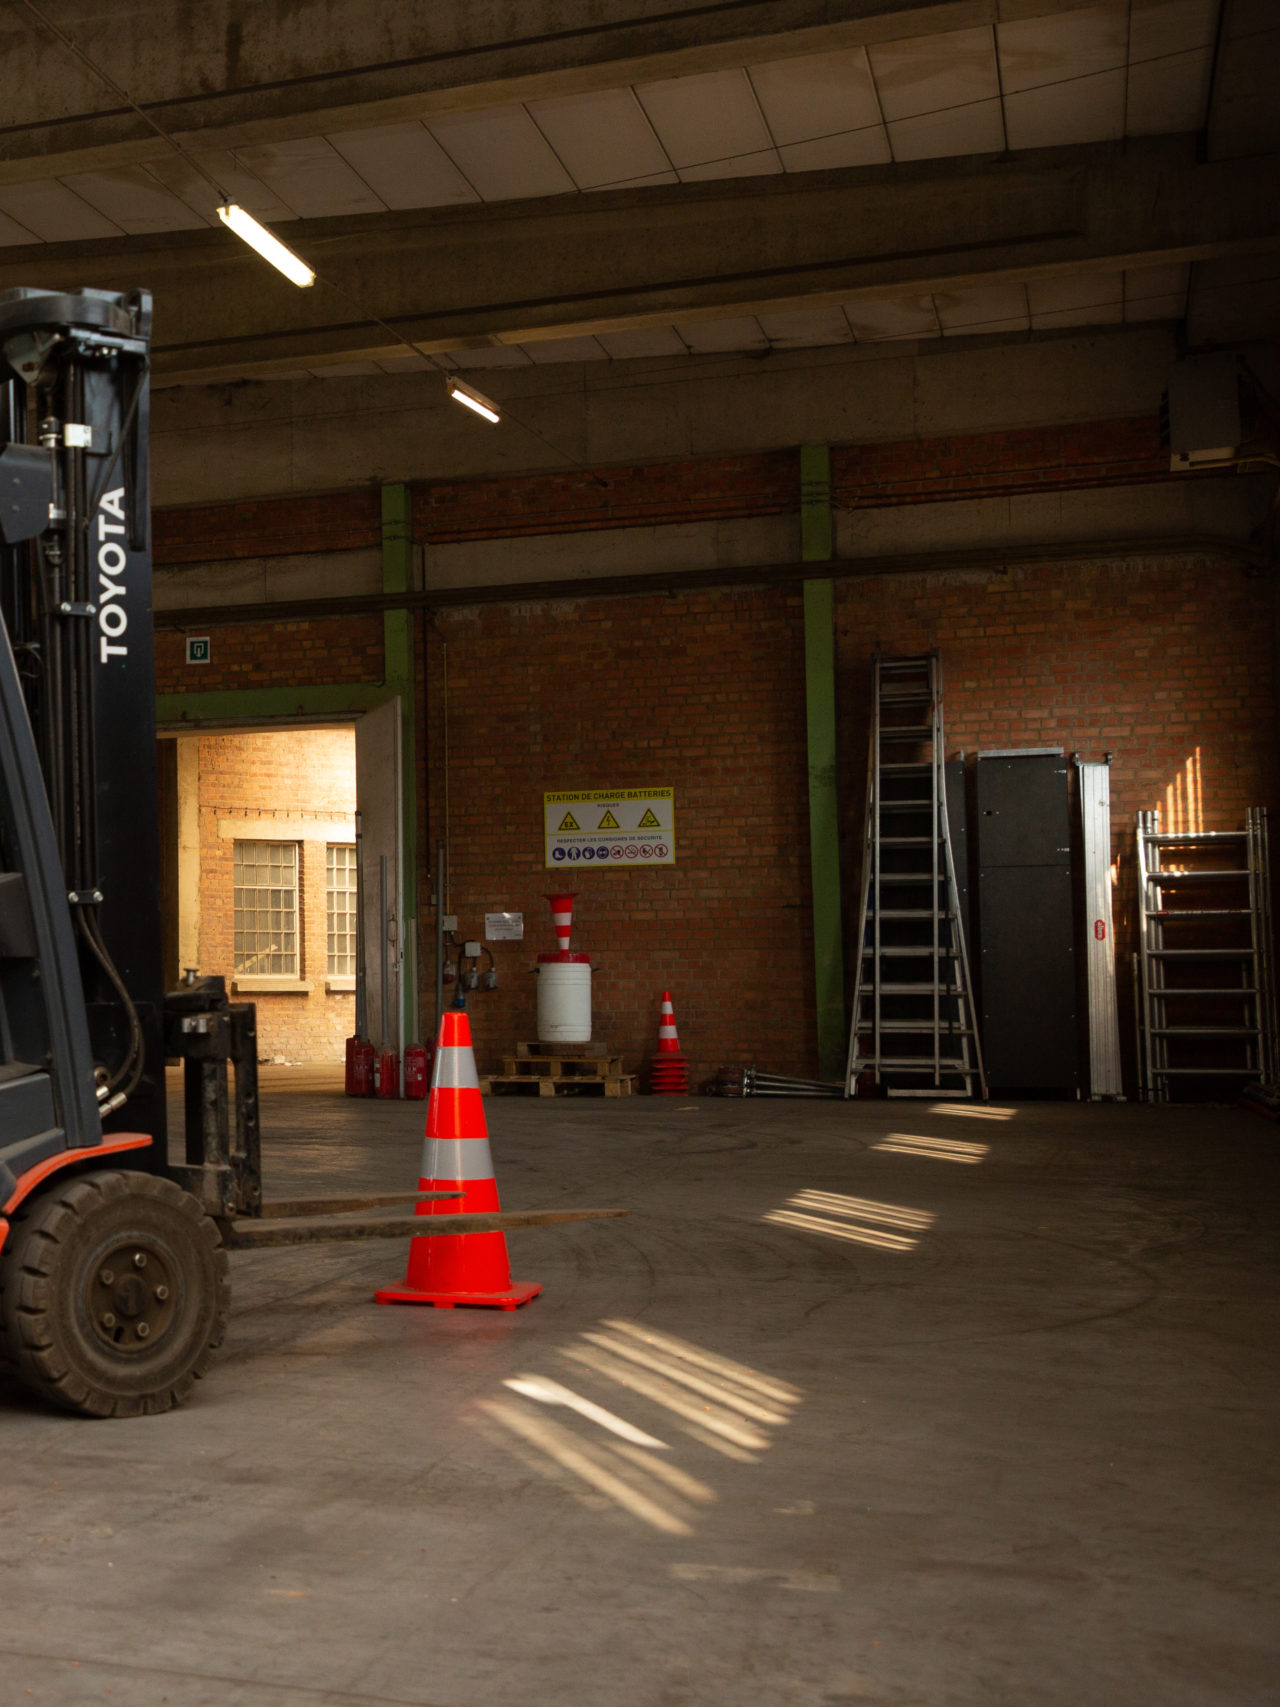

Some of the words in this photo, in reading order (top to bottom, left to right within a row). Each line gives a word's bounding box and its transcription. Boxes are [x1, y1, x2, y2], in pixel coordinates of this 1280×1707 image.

[98, 487, 128, 663] TOYOTA
[546, 793, 580, 802] STATION
[581, 792, 592, 800] DE
[593, 791, 625, 800] CHARGE
[628, 789, 671, 798] BATTERIES
